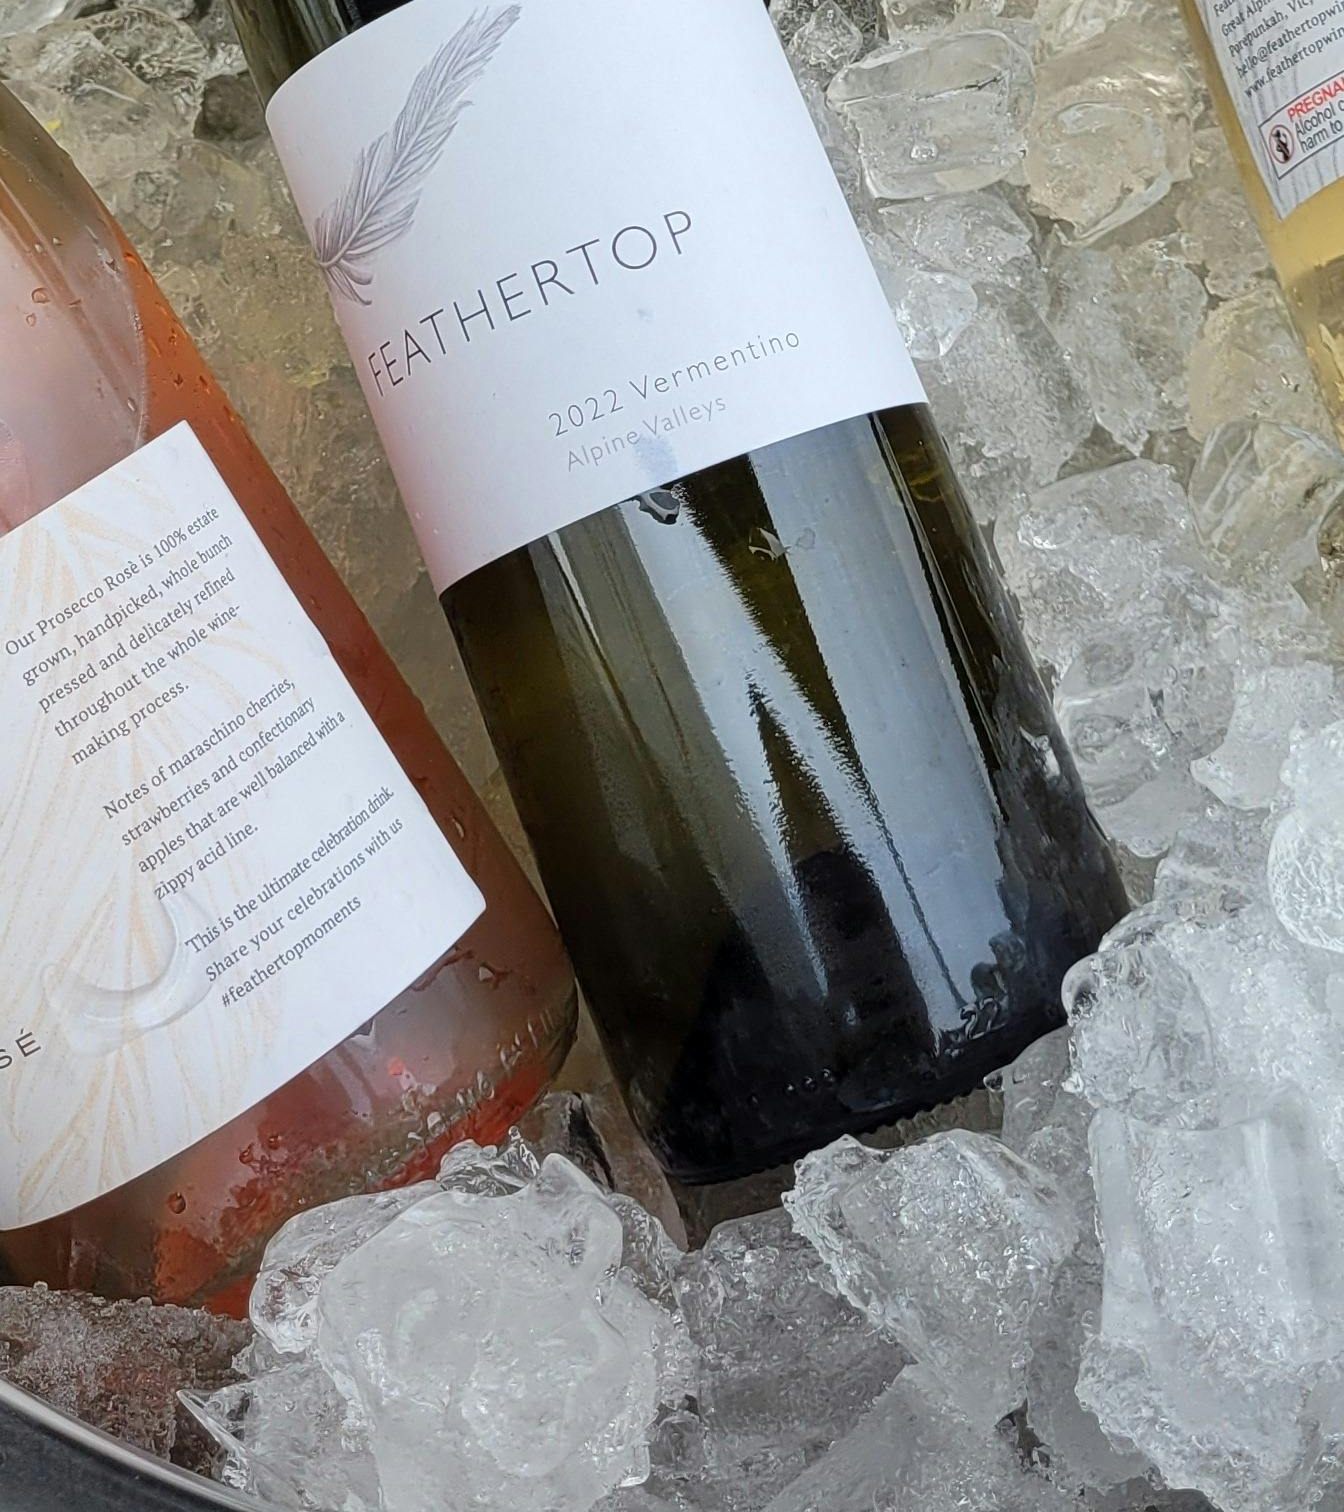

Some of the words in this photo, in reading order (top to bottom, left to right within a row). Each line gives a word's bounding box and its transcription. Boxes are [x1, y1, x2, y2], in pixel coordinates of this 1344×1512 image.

[1221, 10, 1246, 38] Great
[1295, 103, 1337, 139] Alcohol
[1299, 129, 1332, 155] harm
[1327, 116, 1344, 135] to
[367, 210, 692, 397] FEATHERTOP
[548, 389, 624, 437] 2022
[628, 332, 800, 400] Vermentino
[568, 431, 641, 473] Alpine
[642, 397, 726, 439] Valleys
[5, 630, 37, 655] Our
[35, 586, 105, 637] Prosecco
[103, 560, 140, 592] Rosè
[138, 553, 154, 569] is
[152, 527, 188, 559] 100%
[187, 508, 220, 536] estate
[22, 646, 77, 687] grown,
[73, 583, 164, 649] handpicked,
[160, 559, 200, 590] whole
[195, 534, 233, 564] bunch
[38, 662, 99, 714] pressed
[98, 642, 129, 671] and
[129, 599, 194, 650] delicately
[193, 567, 236, 606] refined
[54, 673, 142, 737] throughout
[140, 657, 167, 679] the
[166, 628, 208, 661] whole
[206, 605, 240, 632] wine-
[71, 719, 131, 766] making
[129, 682, 189, 730] process.
[102, 783, 150, 820] Notes
[150, 765, 169, 787] of
[167, 714, 246, 776] maraschino
[246, 678, 296, 718] cherries,
[121, 778, 211, 846] strawberries
[211, 754, 239, 784] and
[238, 696, 315, 763] confectionary
[138, 834, 186, 873] apples
[185, 811, 218, 840] that
[216, 795, 241, 818] are
[237, 770, 269, 800] well
[263, 731, 318, 780] balanced
[314, 715, 340, 740] with
[336, 711, 346, 723] a
[153, 864, 195, 901] zippy
[195, 840, 227, 872] acid
[223, 823, 258, 850] line.
[184, 925, 221, 953] This
[217, 916, 235, 933] is
[233, 899, 259, 921] the
[256, 857, 312, 903] ultimate
[311, 809, 371, 862] celebration
[205, 944, 250, 982] Share
[249, 916, 285, 952] your
[287, 852, 366, 921] celebrations
[364, 829, 392, 857] with
[388, 818, 403, 835] us
[221, 896, 362, 1008] #feathertopmoments
